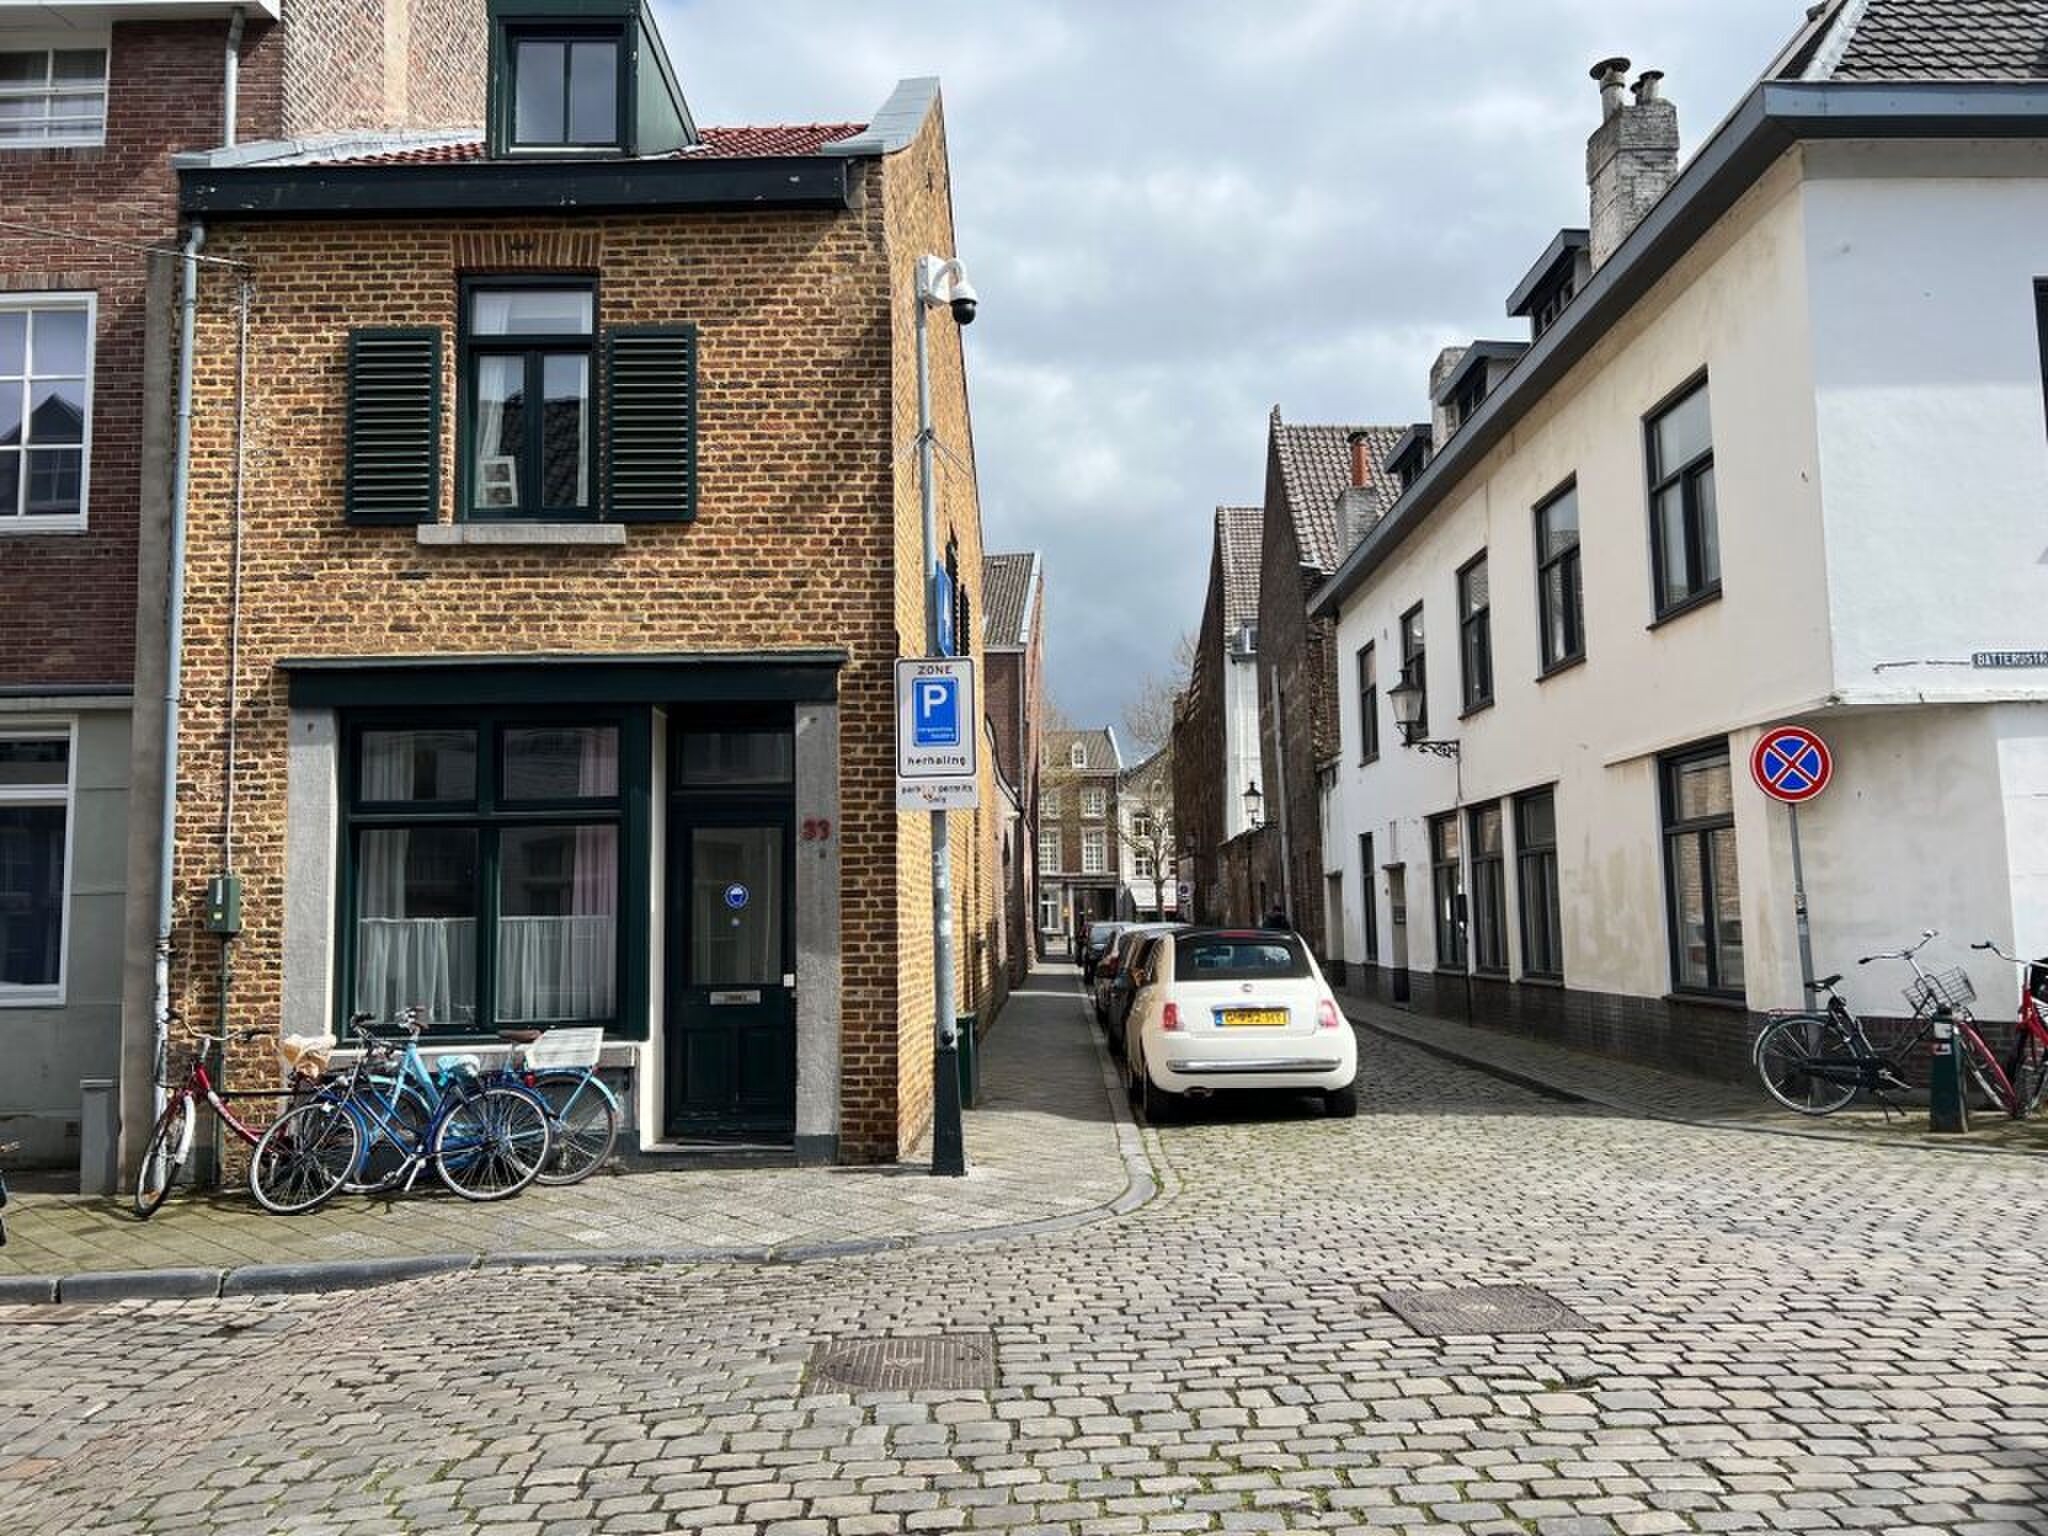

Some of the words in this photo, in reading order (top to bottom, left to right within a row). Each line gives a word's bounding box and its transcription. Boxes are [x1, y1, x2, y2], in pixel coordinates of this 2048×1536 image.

[917, 664, 953, 675] ZONE
[923, 684, 948, 718] P
[907, 755, 966, 767] herhaling
